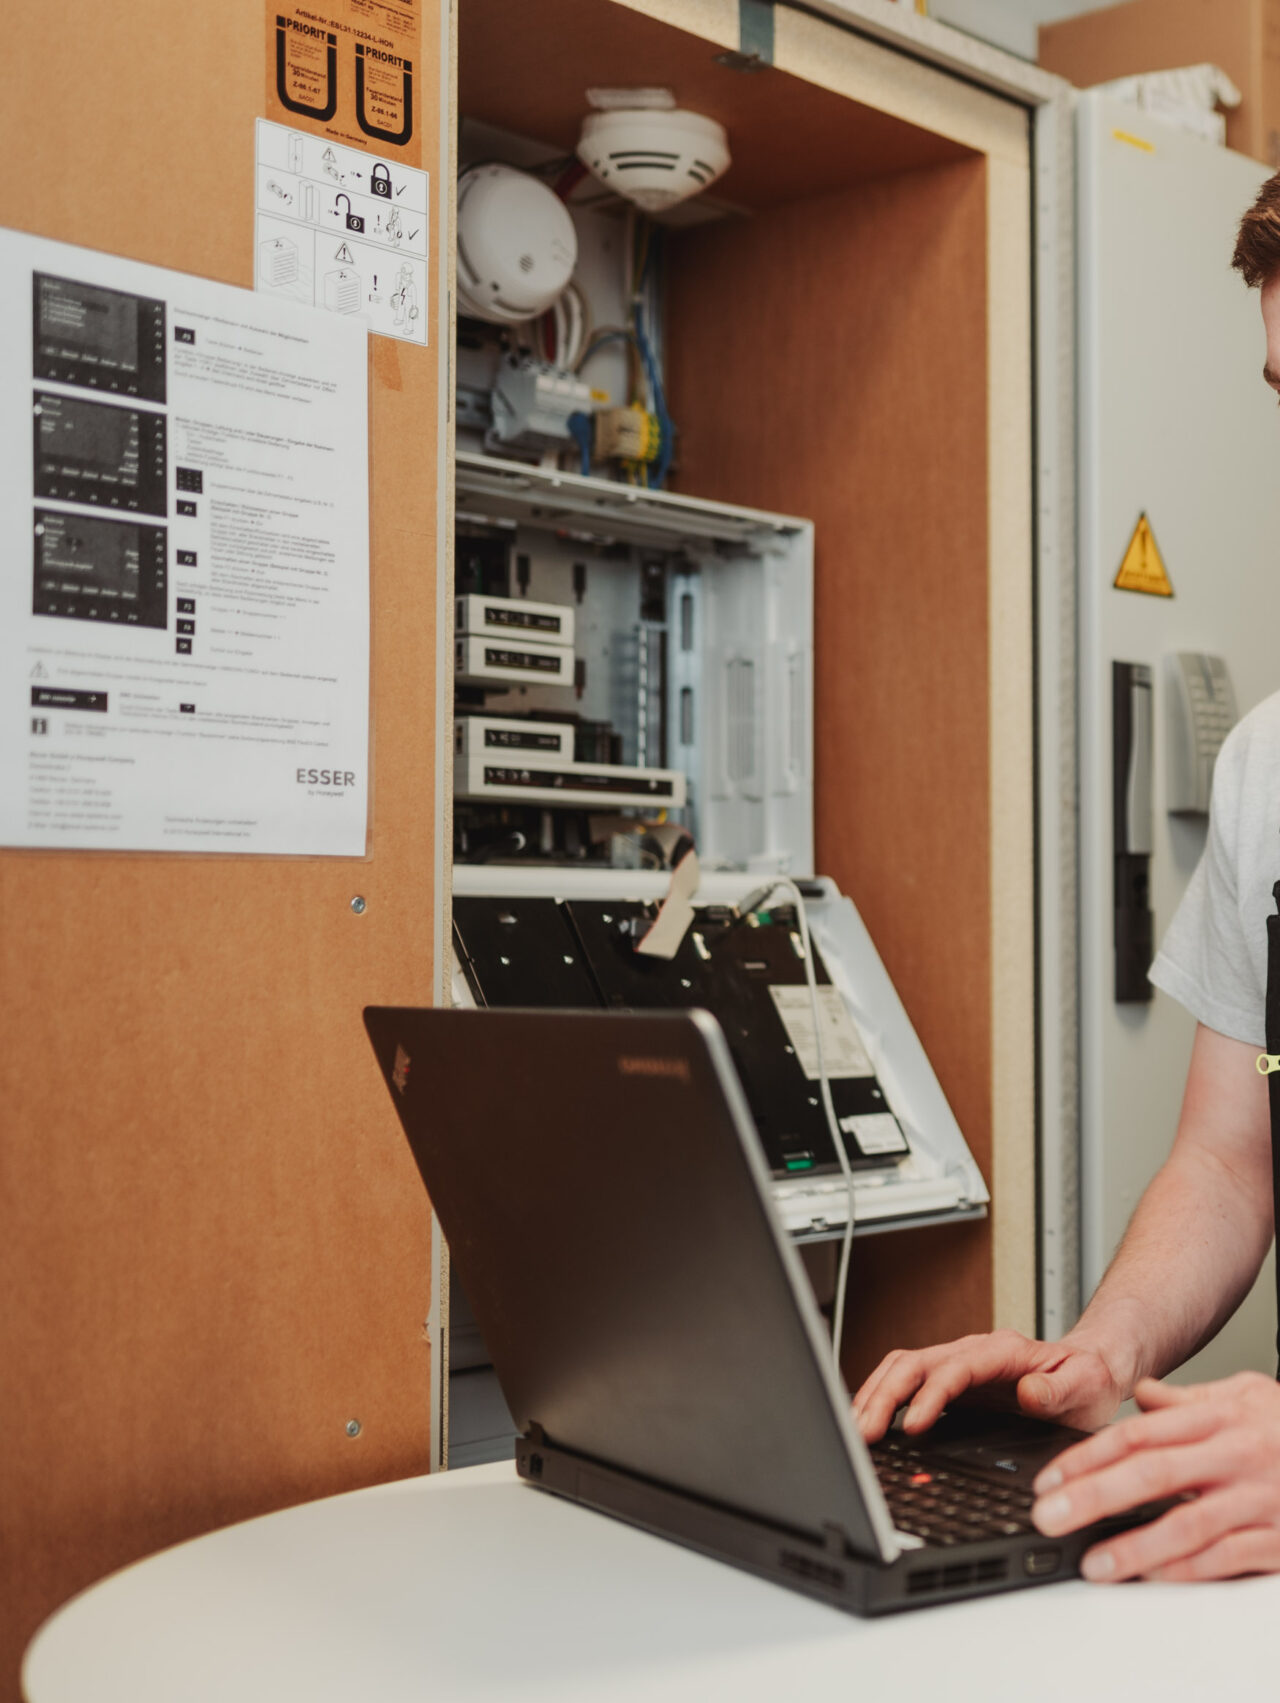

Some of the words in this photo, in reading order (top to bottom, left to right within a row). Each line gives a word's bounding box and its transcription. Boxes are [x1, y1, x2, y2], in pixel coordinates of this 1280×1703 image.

[286, 17, 326, 40] PRIORIT
[366, 46, 403, 67] PRIORIT
[296, 768, 356, 786] ESSER
